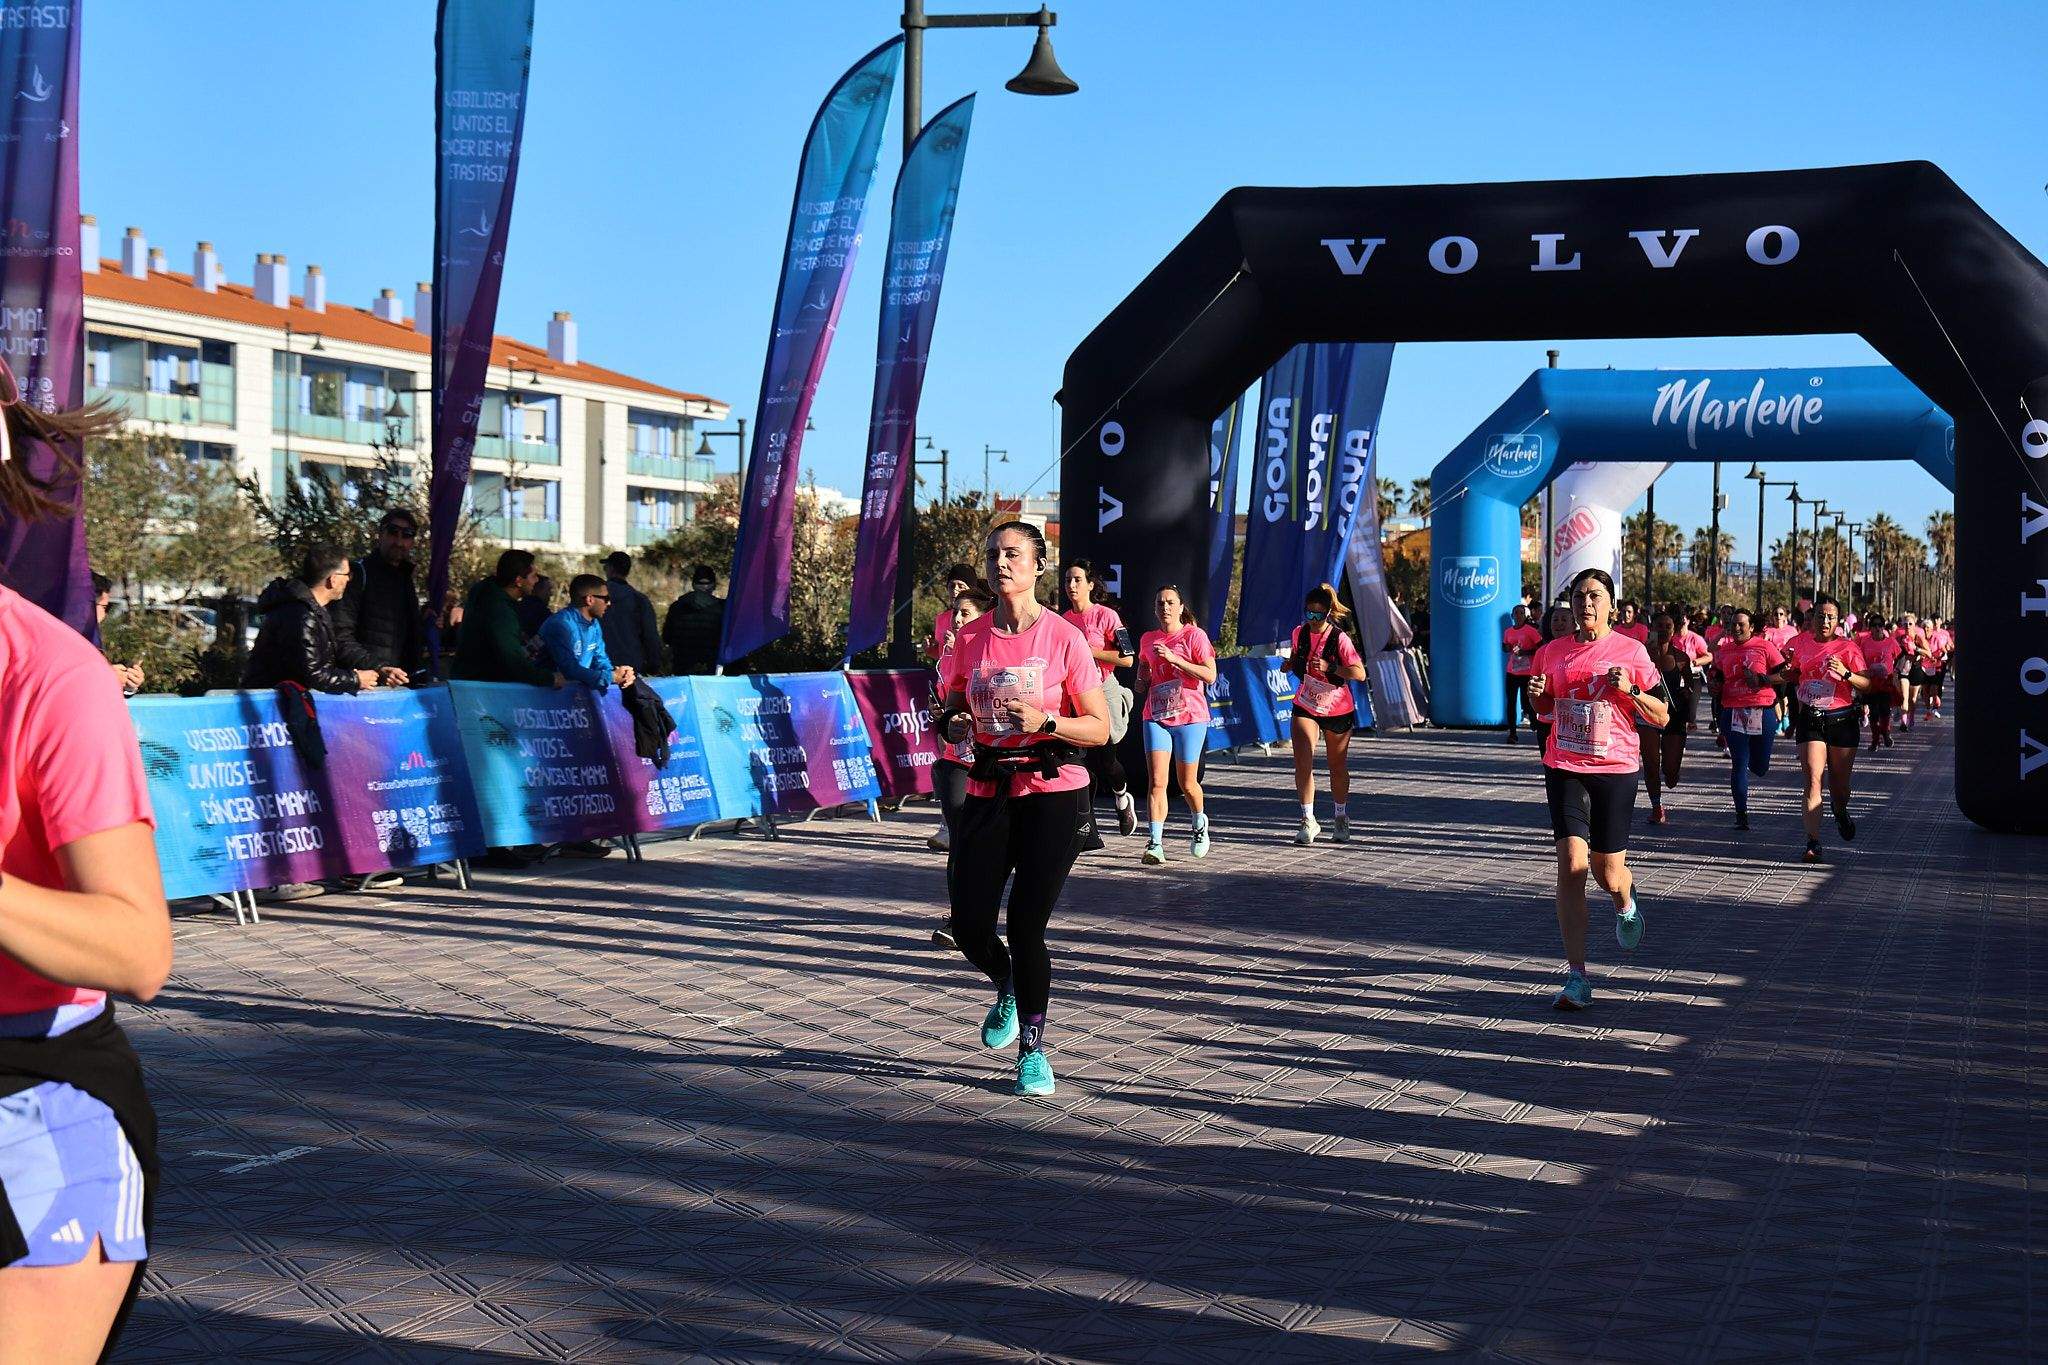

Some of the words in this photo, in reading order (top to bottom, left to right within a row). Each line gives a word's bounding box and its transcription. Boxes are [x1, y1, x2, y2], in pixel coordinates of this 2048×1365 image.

[478, 140, 493, 157] DE
[1321, 225, 1799, 275] VOLVO
[1652, 377, 1824, 450] Marlene
[1263, 397, 1292, 523] GOYA
[1488, 443, 1538, 466] Marlene
[1305, 413, 1333, 531] GOYA
[1443, 568, 1496, 594] Marlene
[992, 697, 1020, 709] 01
[1571, 723, 1592, 734] 016
[188, 760, 244, 790] JUNTOS
[244, 760, 267, 785] EL
[580, 765, 609, 785] MAMA
[200, 793, 260, 825] CÁNCER
[256, 795, 277, 818] DE
[275, 789, 322, 817] MAMA
[225, 822, 324, 861] METASTÁSICO
